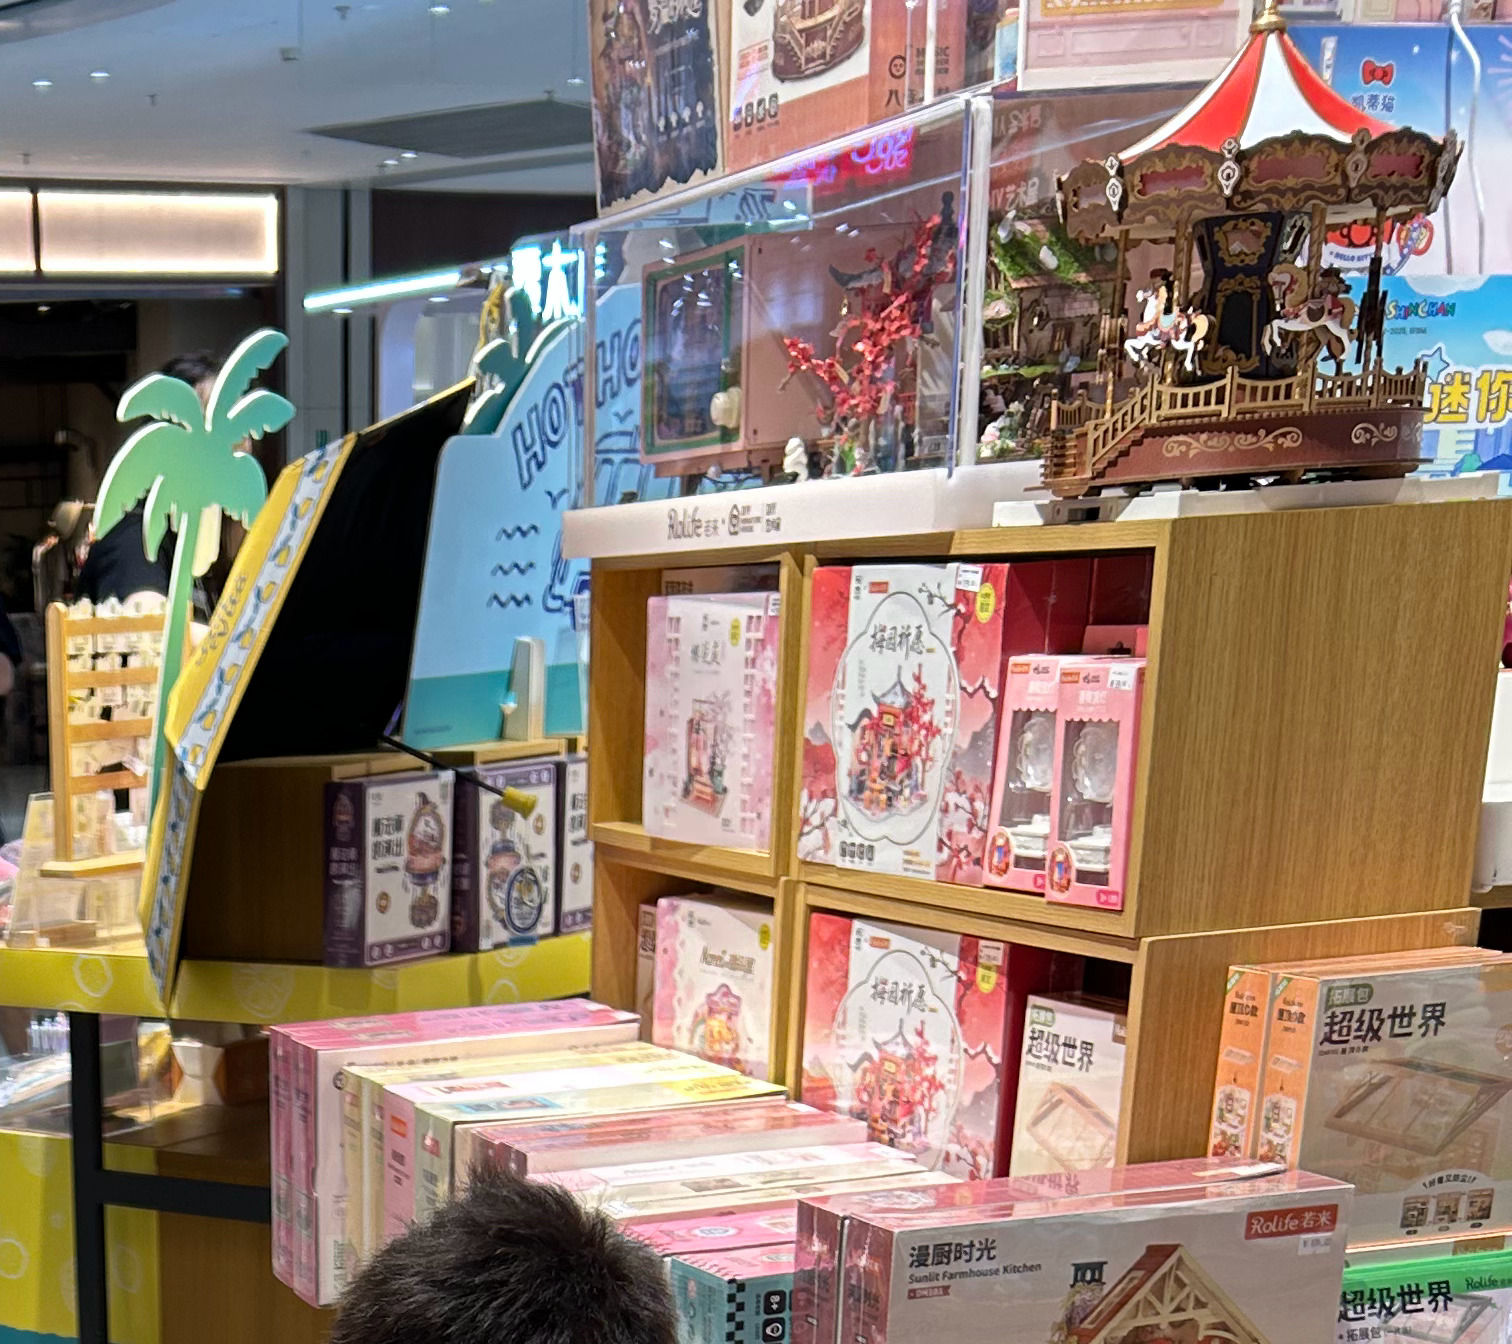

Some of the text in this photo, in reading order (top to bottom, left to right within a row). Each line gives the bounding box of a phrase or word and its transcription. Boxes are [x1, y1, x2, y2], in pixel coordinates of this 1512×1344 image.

[1386, 298, 1457, 321] SHINCHAN
[1424, 369, 1512, 425] 迷你
[1319, 1001, 1447, 1047] 超级世界
[1025, 1026, 1095, 1073] 超级世界
[1249, 1211, 1299, 1236] Rolife
[908, 1238, 997, 1269] 漫厨时光
[908, 1261, 1043, 1285] Sunlit Farmhouse Kitchen
[1465, 1274, 1499, 1291] Rolife
[1338, 1279, 1454, 1323] 超级世界
[1346, 1326, 1381, 1343] 拓展包
